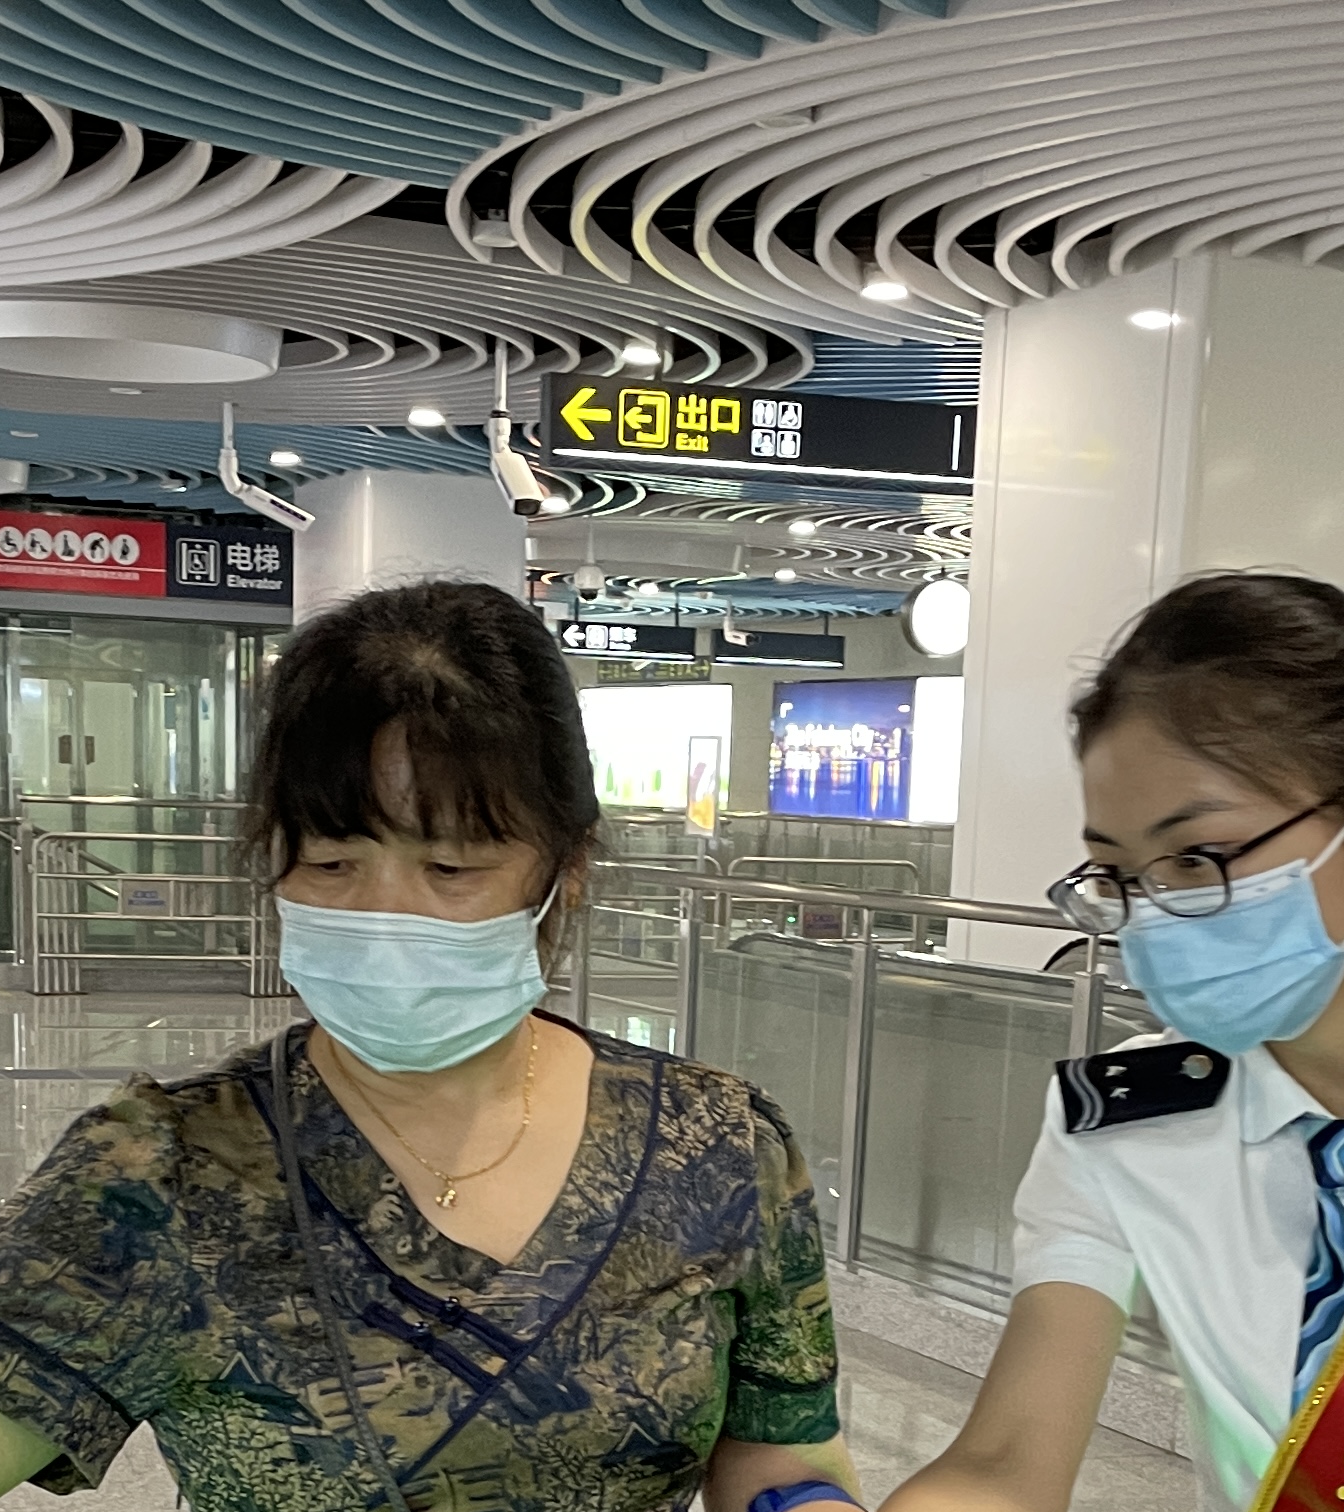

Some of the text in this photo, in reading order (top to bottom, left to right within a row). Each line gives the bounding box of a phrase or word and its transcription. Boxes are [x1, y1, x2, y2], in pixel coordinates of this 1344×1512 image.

[676, 394, 740, 433] 出口
[676, 432, 709, 452] Exit
[227, 542, 280, 573] 电梯
